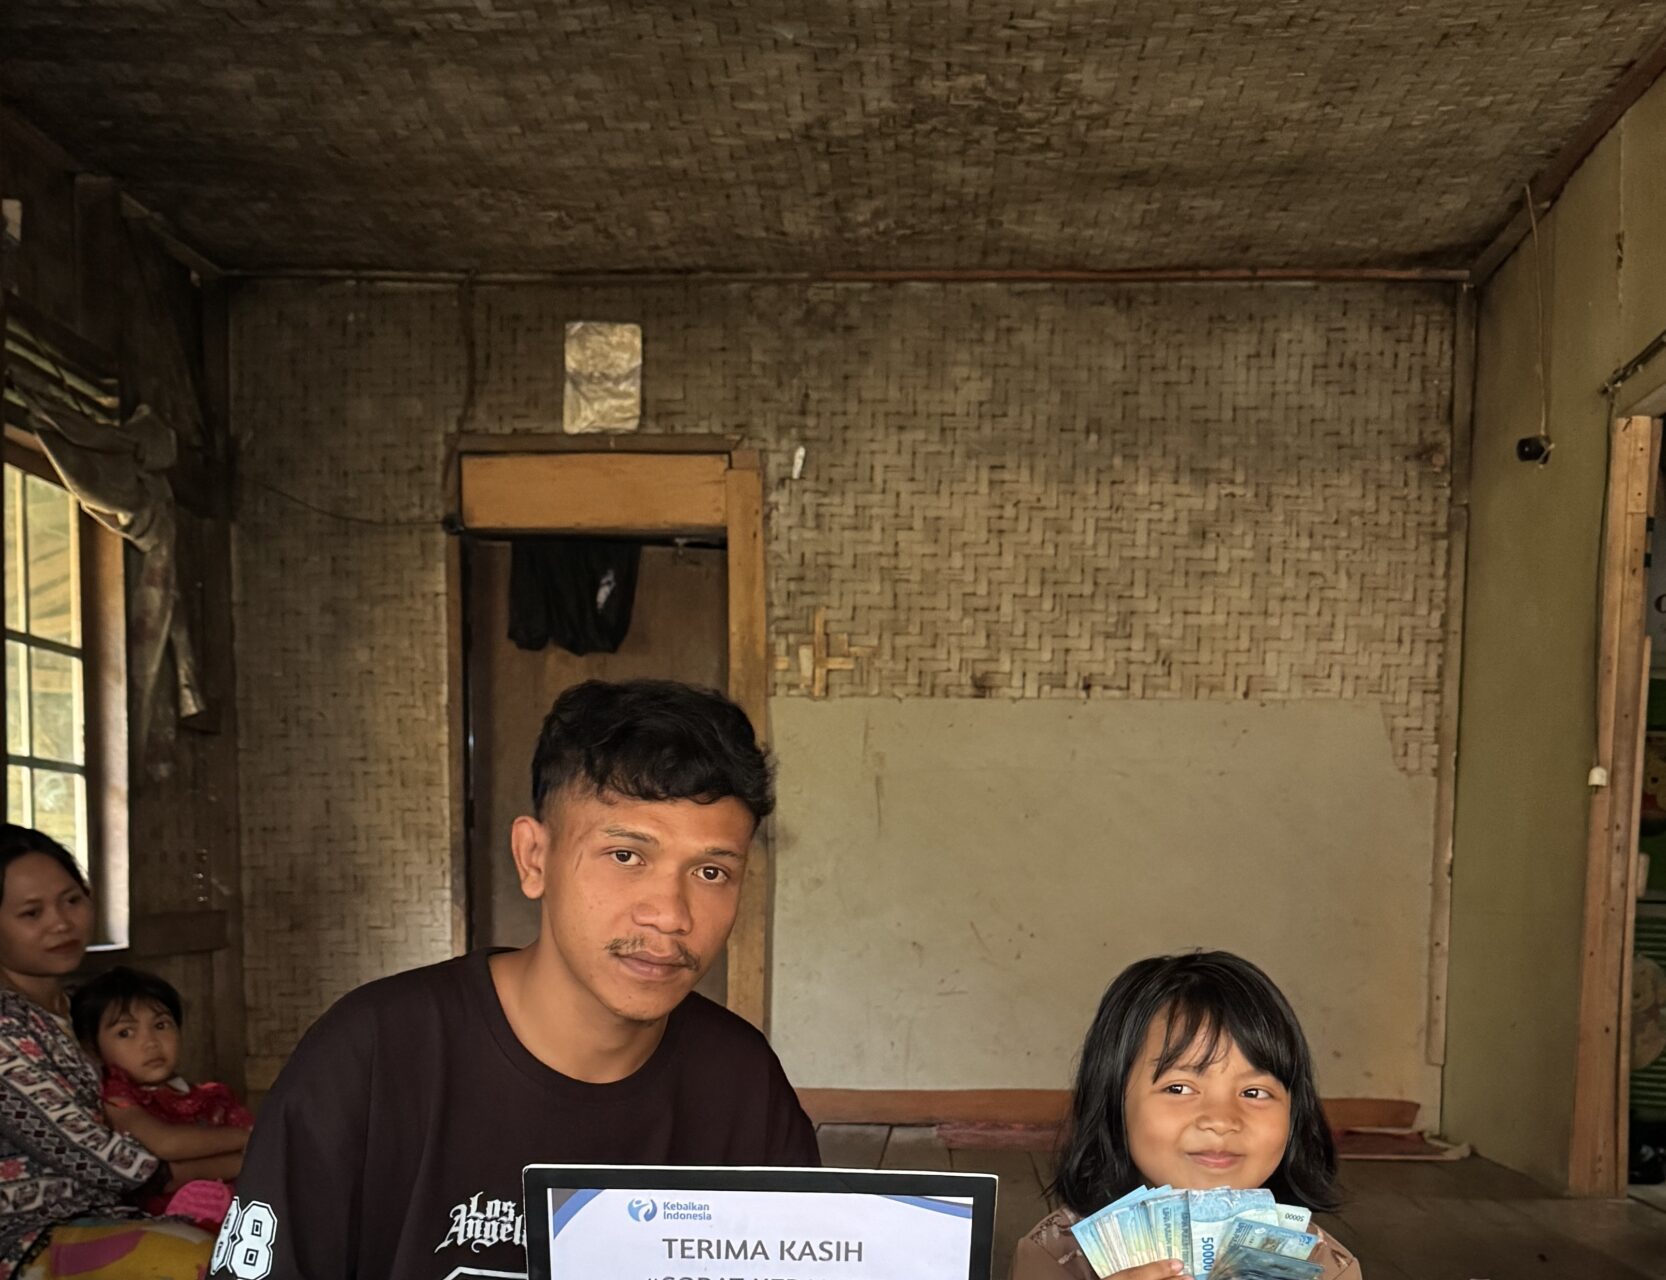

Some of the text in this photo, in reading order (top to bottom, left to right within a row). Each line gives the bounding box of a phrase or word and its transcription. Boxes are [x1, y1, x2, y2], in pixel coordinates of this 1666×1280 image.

[663, 1201, 710, 1212] Kebaikan
[663, 1211, 712, 1221] Indonesia
[435, 1203, 527, 1253] Angel
[662, 1238, 863, 1262] TERIMA KASIH
